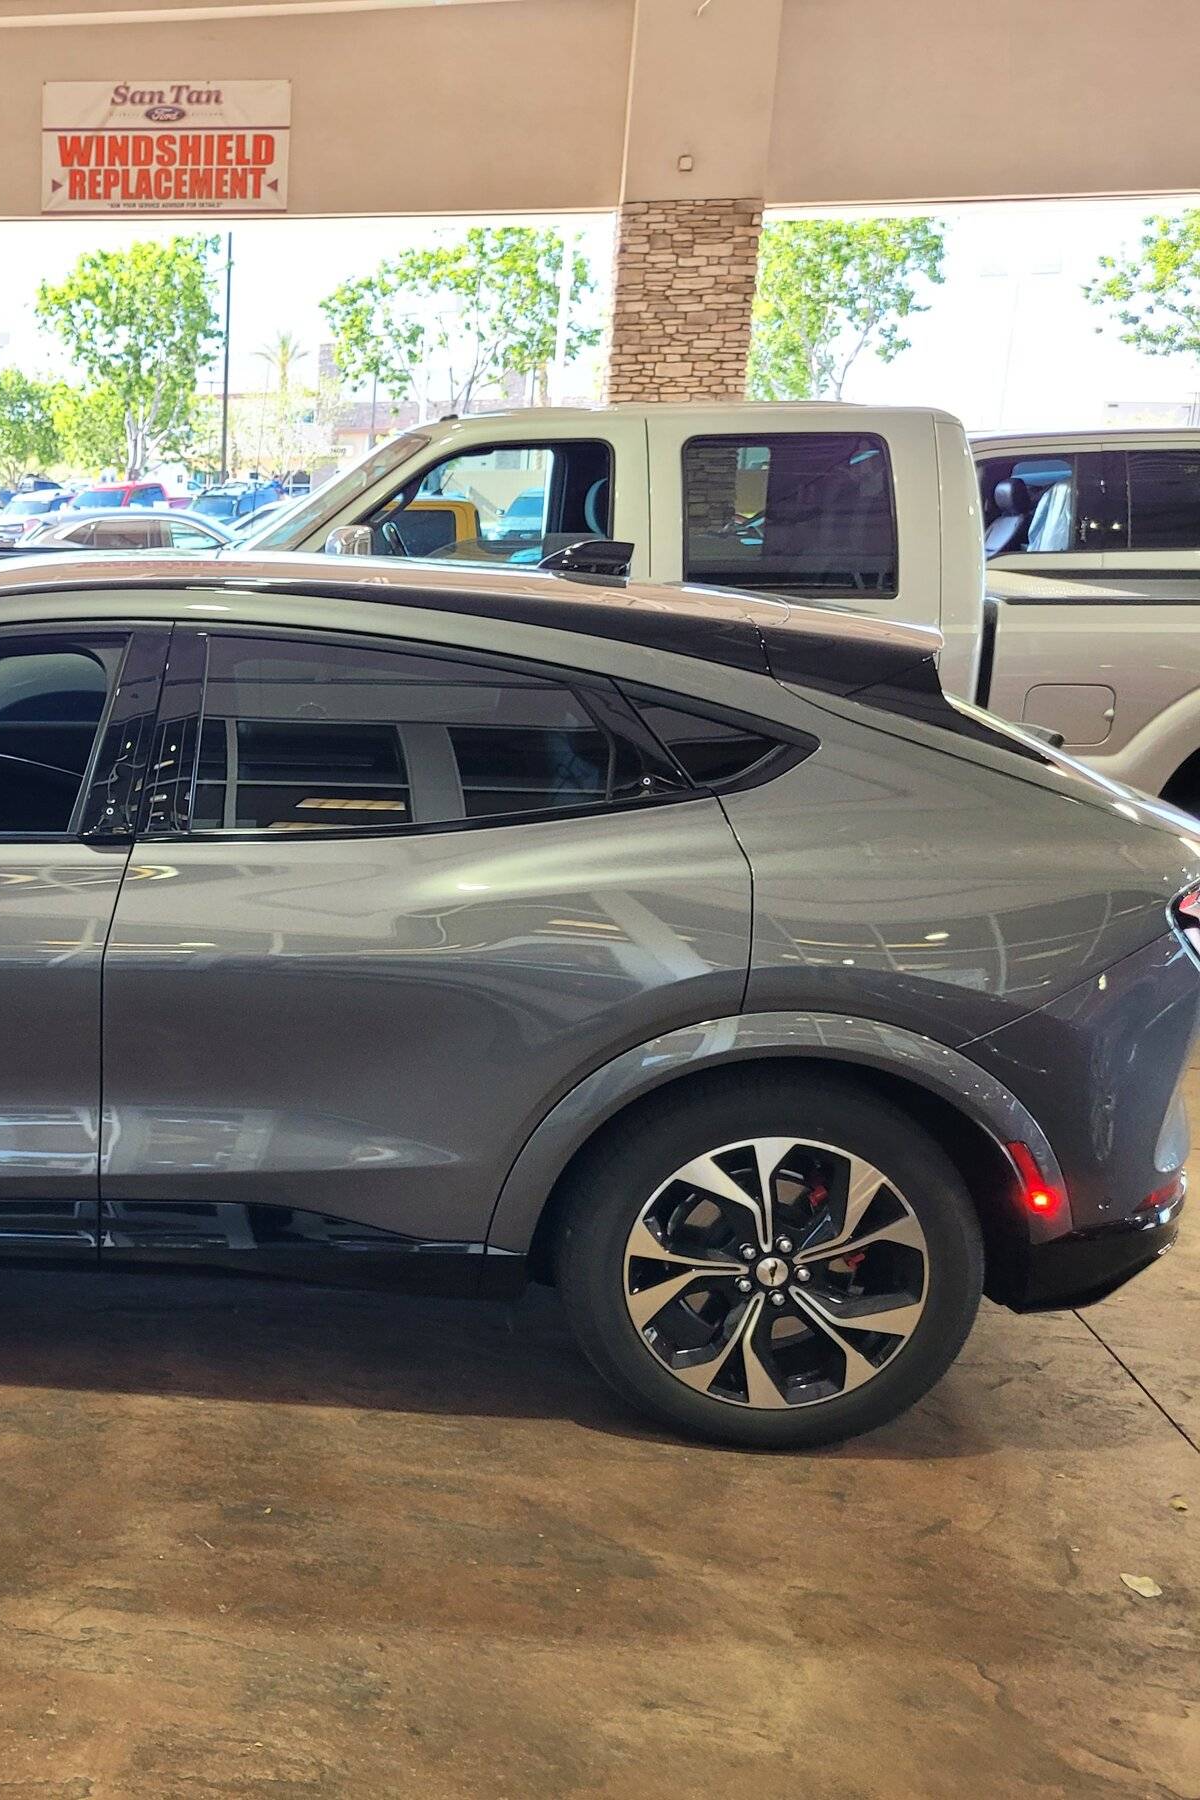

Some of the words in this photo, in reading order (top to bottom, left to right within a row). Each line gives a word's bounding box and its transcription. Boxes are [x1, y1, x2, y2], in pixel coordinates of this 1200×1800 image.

[110, 84, 165, 106] San
[170, 84, 224, 106] Tan
[149, 107, 183, 121] Ford
[57, 133, 276, 168] WINDSHIELD
[67, 167, 267, 200] REPLACEMENT
